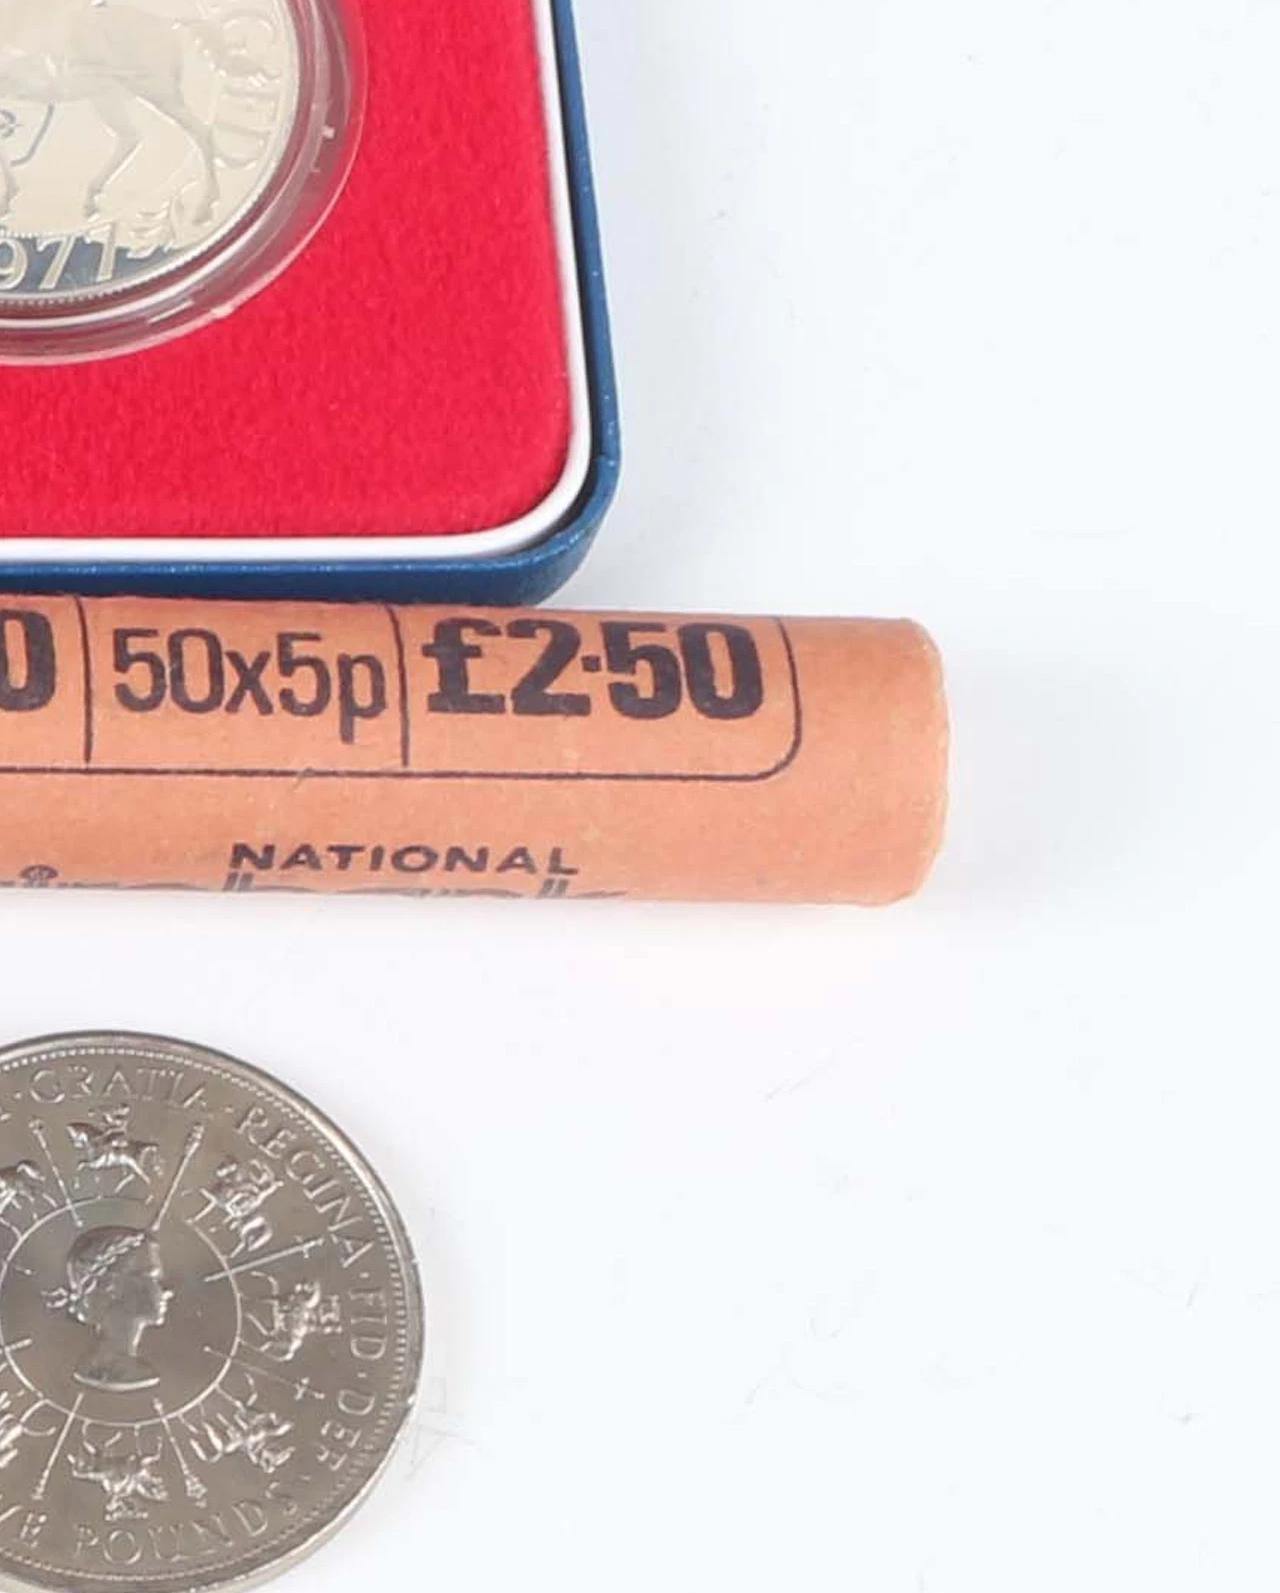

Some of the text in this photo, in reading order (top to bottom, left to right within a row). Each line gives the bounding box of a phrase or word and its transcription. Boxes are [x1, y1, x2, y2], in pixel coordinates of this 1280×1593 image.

[113, 627, 388, 744] 50x5p
[230, 841, 580, 877] NATIONAL
[28, 1062, 213, 1110] GRATIA
[236, 1104, 378, 1270] REGINA
[348, 1282, 391, 1362] FID
[73, 1481, 302, 1569] POUNDS
